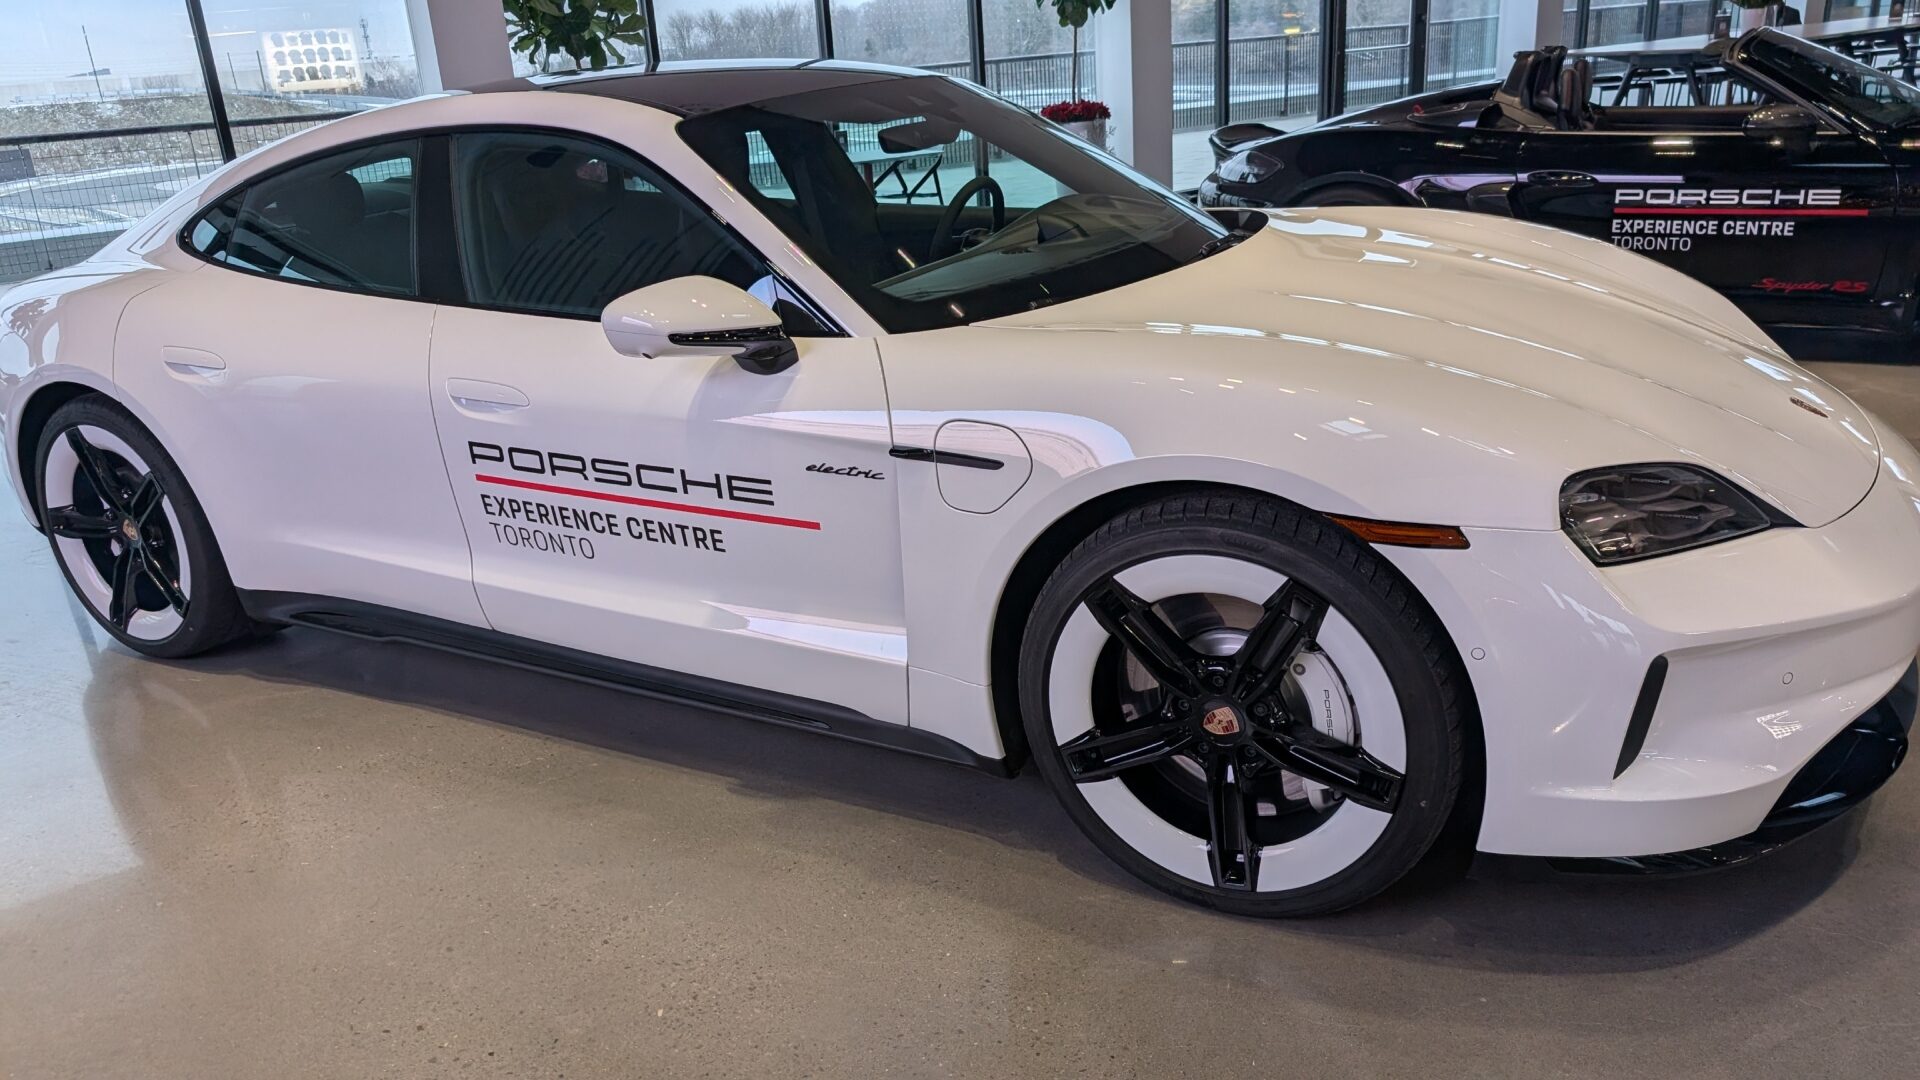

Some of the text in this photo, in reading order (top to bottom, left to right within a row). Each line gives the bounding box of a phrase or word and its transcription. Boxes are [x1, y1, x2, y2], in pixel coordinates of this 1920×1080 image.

[1614, 189, 1841, 205] PORSCHE
[1611, 219, 1795, 236] EXPERIENCE CENTRE
[1611, 236, 1691, 251] TORONTO
[1752, 278, 1869, 294] Spyder RS
[468, 440, 775, 507] PORSCHE
[805, 463, 886, 480] electric
[479, 493, 727, 553] EXPERIENCE CENTRE
[489, 521, 596, 560] TORONTO
[1323, 689, 1334, 737] PORSC
